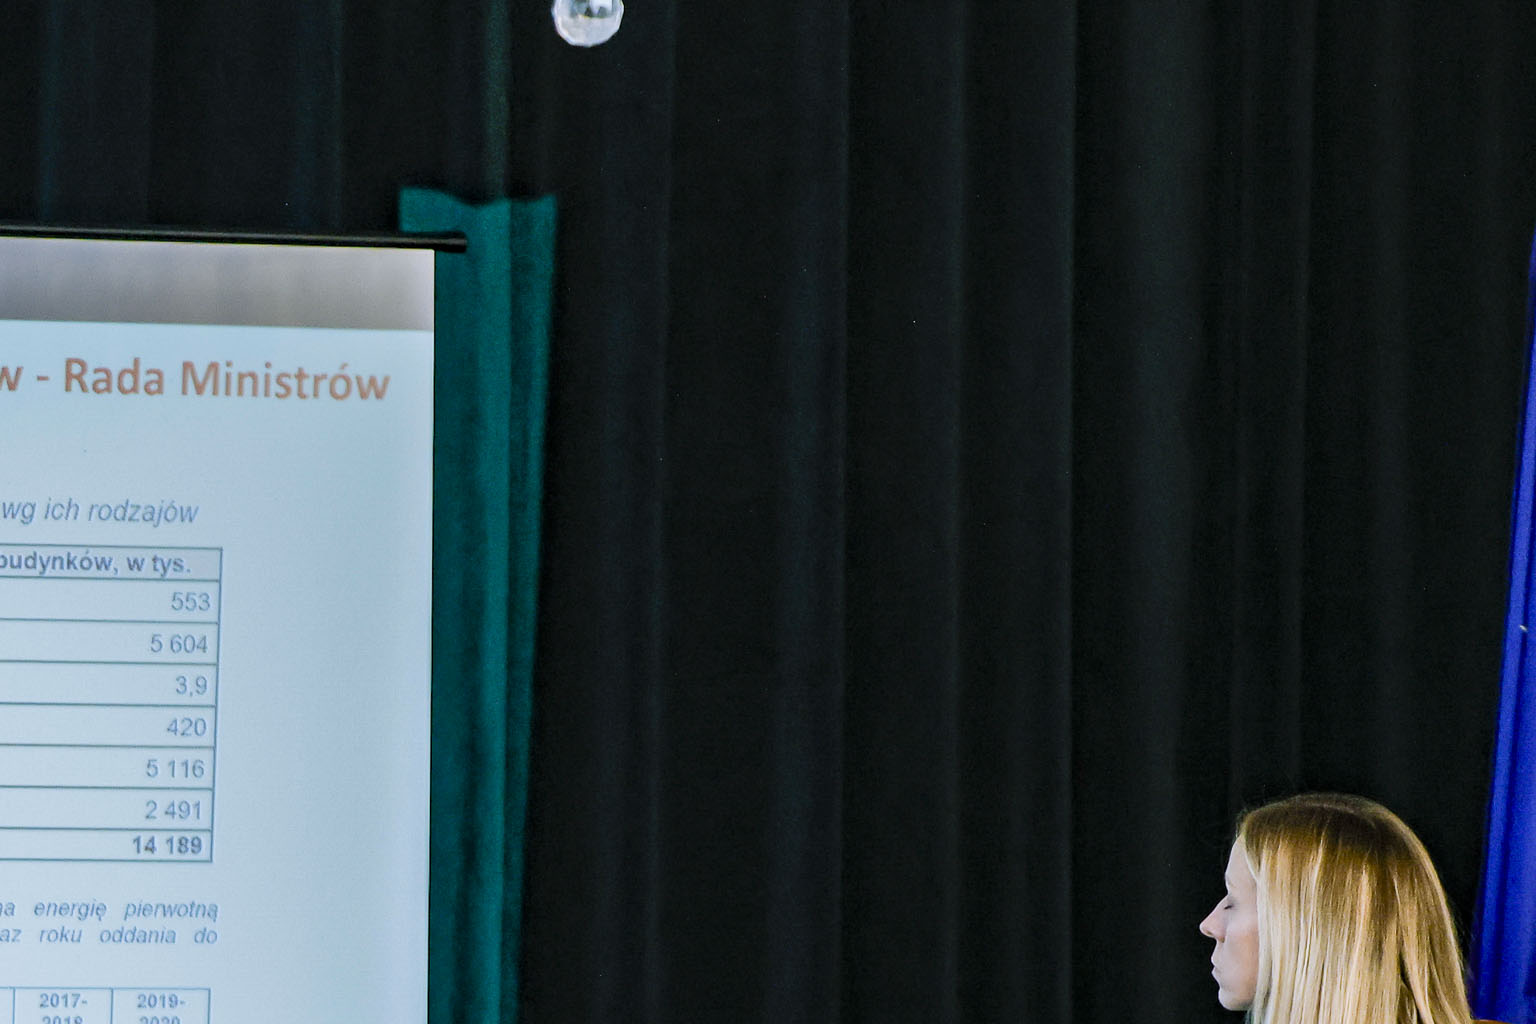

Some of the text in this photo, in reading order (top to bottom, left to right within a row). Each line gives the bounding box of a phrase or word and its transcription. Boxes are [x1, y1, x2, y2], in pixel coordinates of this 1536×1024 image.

[64, 356, 164, 397] Rada
[180, 360, 391, 401] Ministrów
[1, 501, 37, 526] wg
[43, 497, 80, 521] ich
[87, 498, 199, 529] rodzajów
[126, 557, 146, 572] w
[150, 554, 192, 578] tys.
[170, 591, 211, 612] 553
[150, 633, 208, 654] 5 604
[175, 675, 208, 697] 3,9
[165, 717, 207, 737] 420
[145, 758, 205, 779] 5 116
[144, 799, 201, 821] 2 491
[132, 835, 203, 855] 14 189
[33, 902, 107, 922] energię
[123, 900, 219, 923] pierwotną
[39, 925, 83, 944] roku
[99, 925, 177, 944] oddania
[193, 926, 218, 944] do
[38, 992, 88, 1009] 2017-
[136, 993, 185, 1009] 2019-
